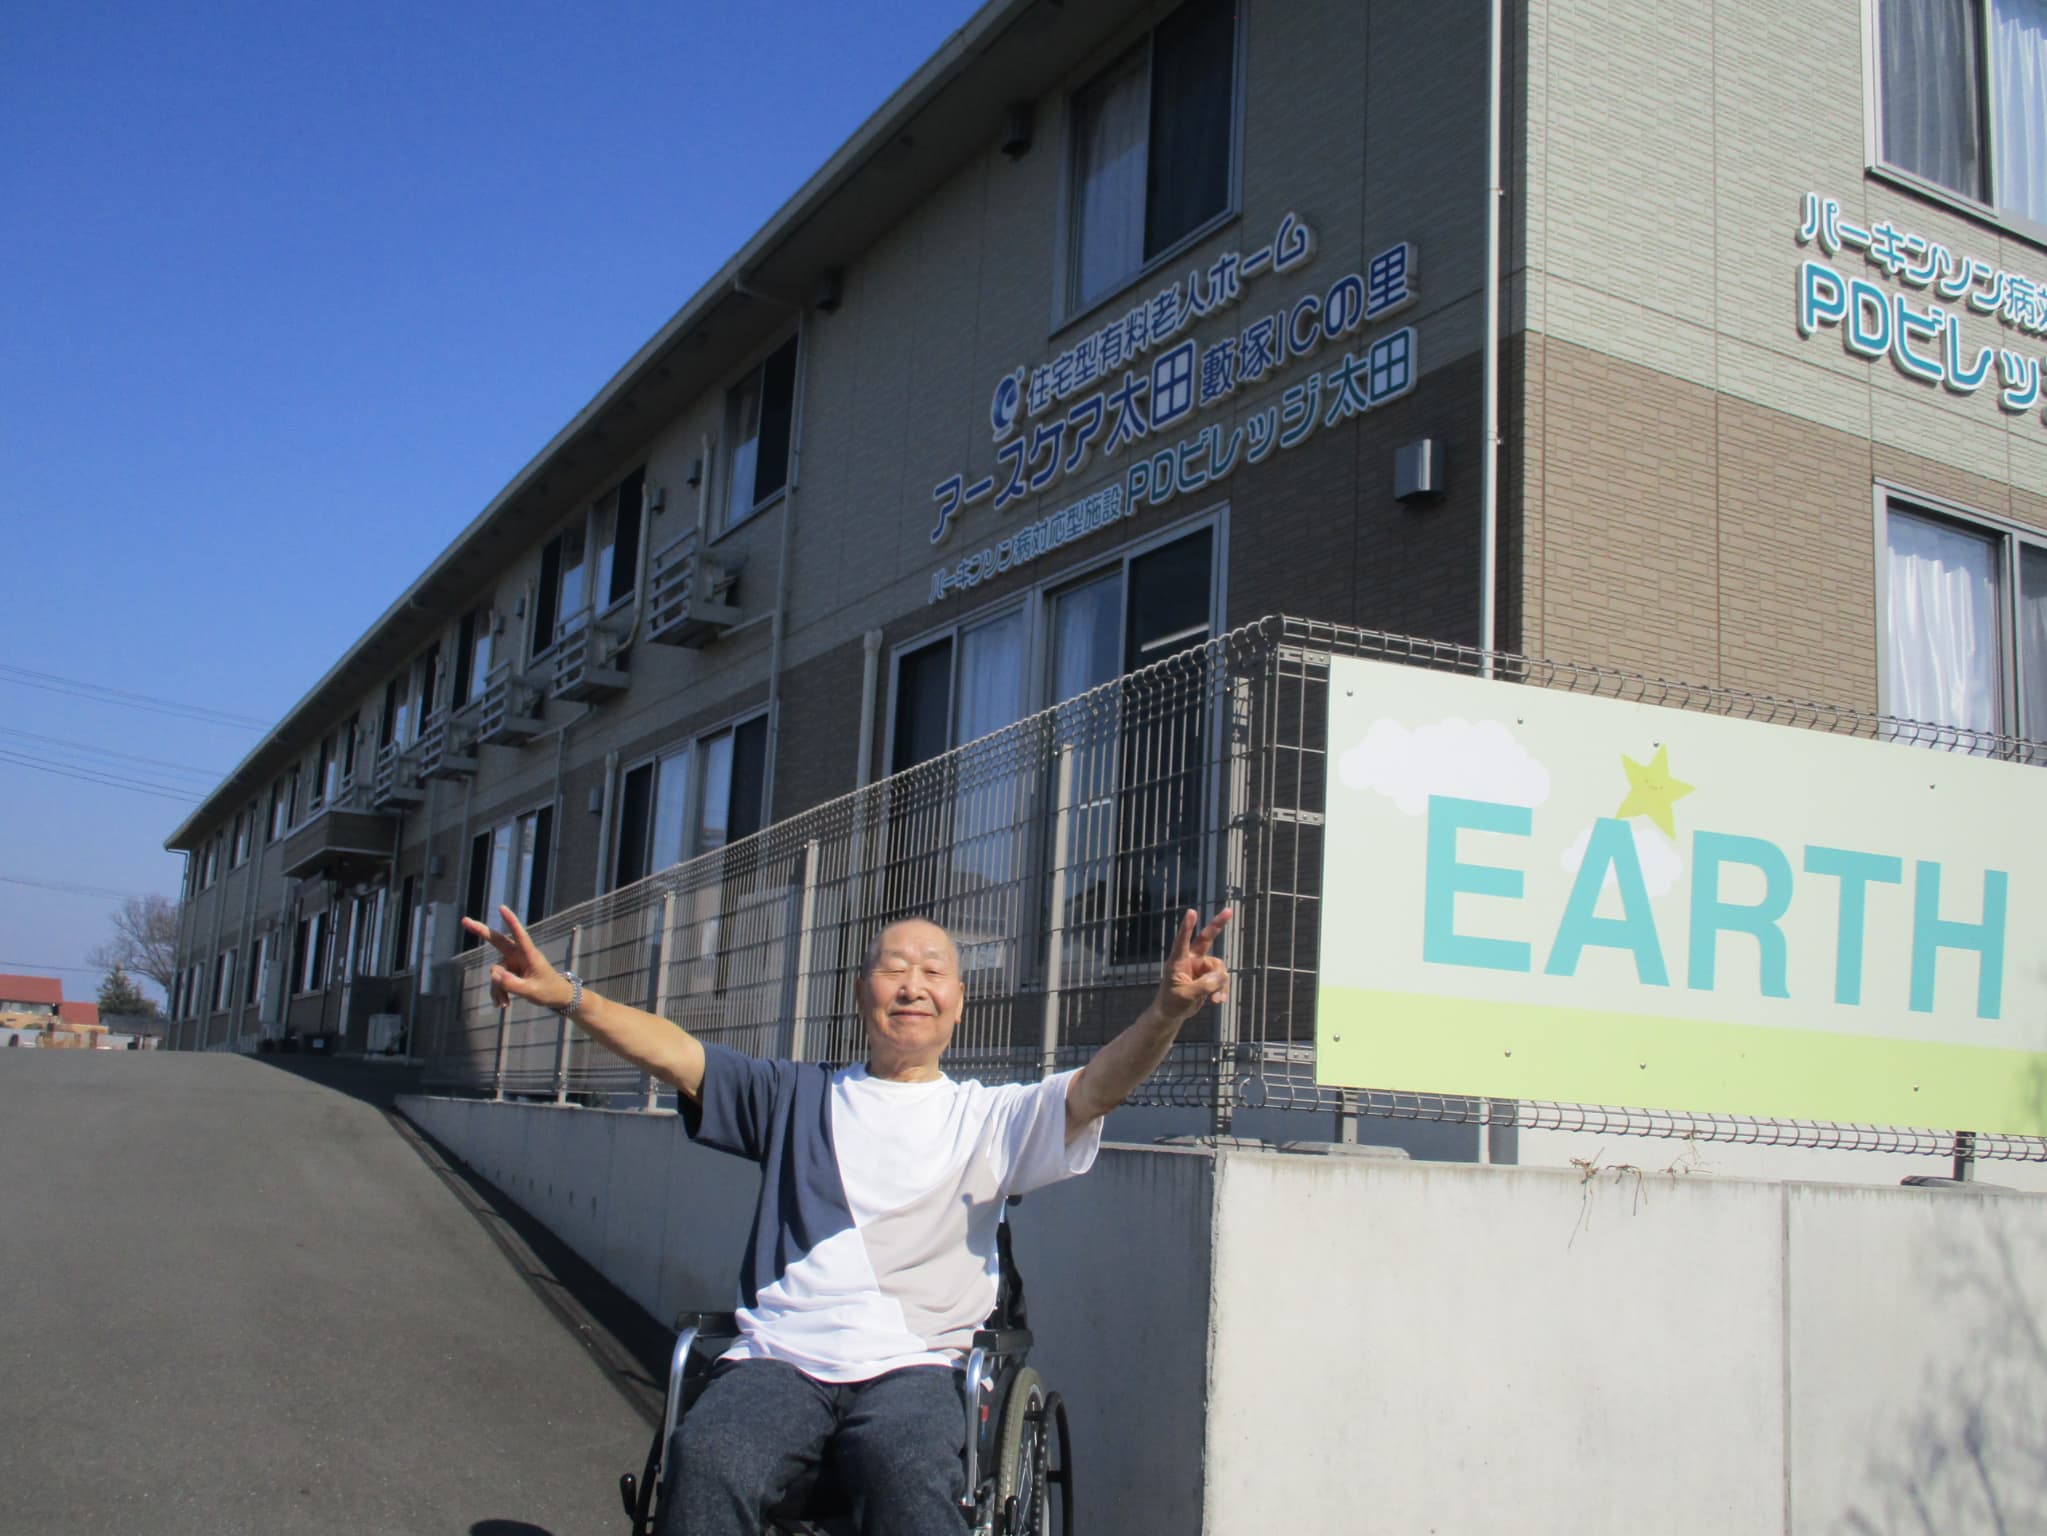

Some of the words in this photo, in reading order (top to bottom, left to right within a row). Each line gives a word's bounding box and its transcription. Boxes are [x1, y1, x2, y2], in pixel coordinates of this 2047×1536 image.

[1028, 212, 1308, 415] 住宅型有料老人ホーム
[1803, 260, 2047, 409] PDビレッ
[929, 484, 1122, 603] パーキンソン病対応型施設
[1126, 327, 1413, 515] PDビレッジ太田
[931, 341, 1196, 542] アースケア太田
[1423, 795, 2008, 1019] EARTH
